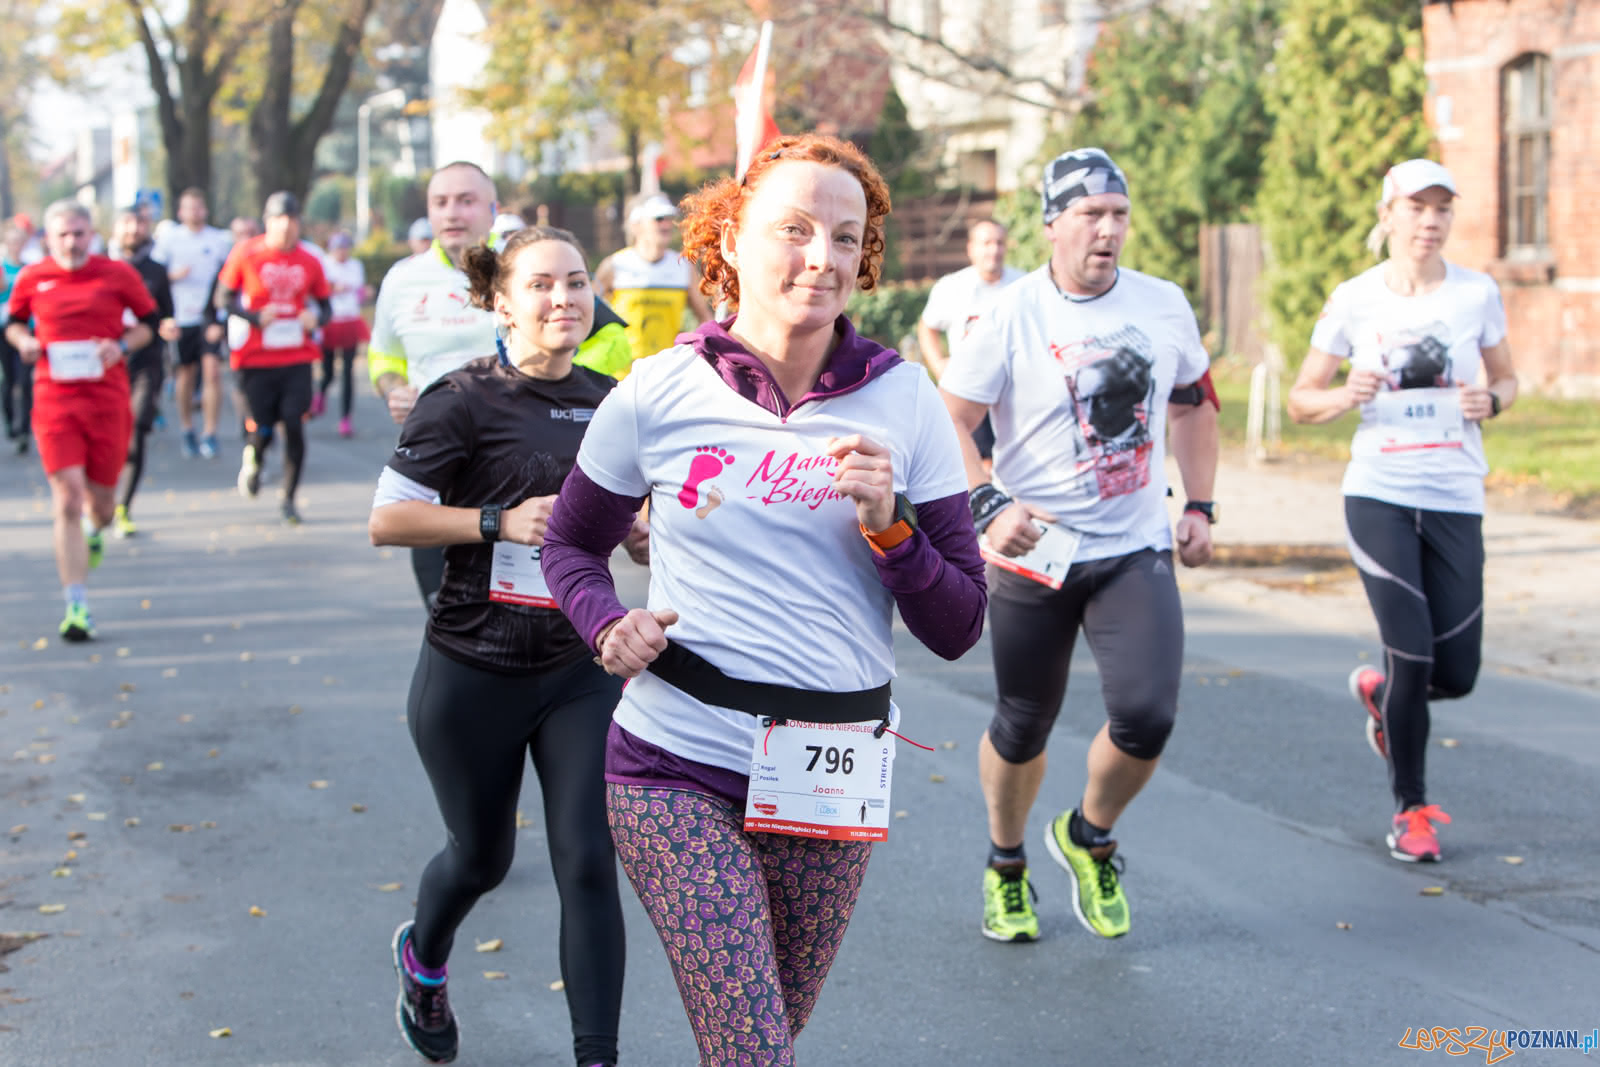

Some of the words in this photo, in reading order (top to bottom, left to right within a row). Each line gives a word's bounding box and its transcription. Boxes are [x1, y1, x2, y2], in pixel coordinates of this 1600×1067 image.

[818, 722, 834, 731] BIEG
[882, 747, 888, 755] D
[805, 745, 854, 775] 796
[880, 757, 888, 789] STREFA
[812, 784, 845, 795] Joanna
[812, 828, 829, 836] Polski
